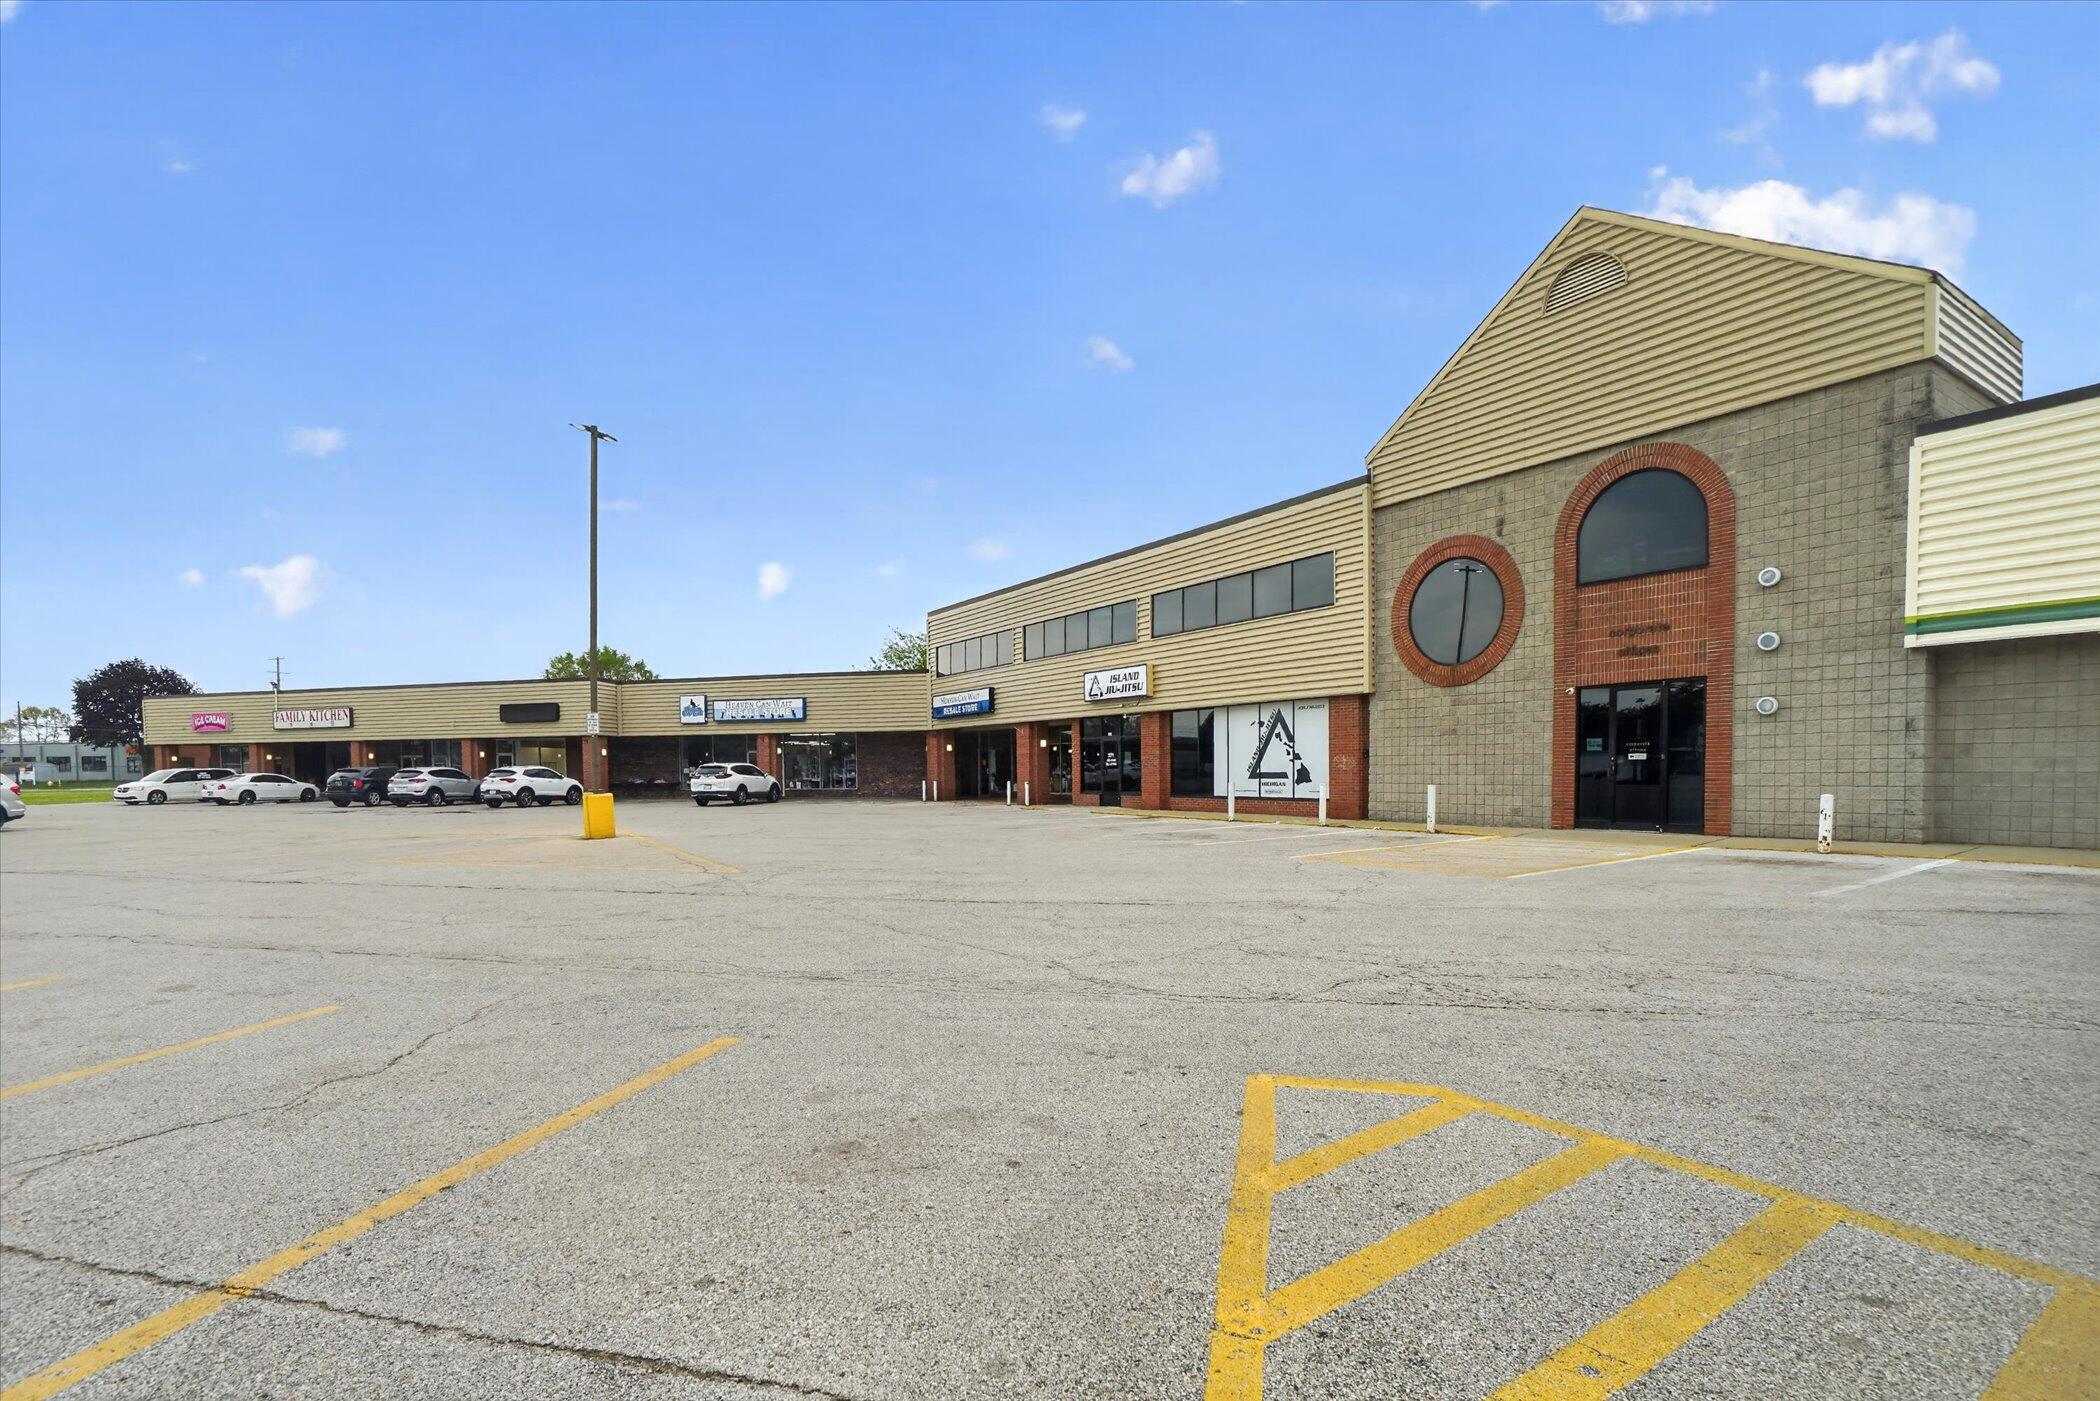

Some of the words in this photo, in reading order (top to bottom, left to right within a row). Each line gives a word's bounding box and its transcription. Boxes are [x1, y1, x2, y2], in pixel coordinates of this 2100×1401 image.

[1109, 671, 1140, 683] ISLAND
[1104, 682, 1144, 695] JIU-JITSU
[725, 700, 755, 709] HEAVEN
[755, 700, 771, 708] CAN
[772, 700, 793, 708] WAIT
[943, 705, 961, 715] RESALE
[961, 703, 978, 713] STORE
[275, 710, 306, 722] FAMILY
[308, 708, 349, 722] KITCHEN
[727, 708, 763, 716] RESALE
[763, 707, 791, 715] STORE
[194, 715, 204, 726] ICE
[204, 713, 227, 725] CREAM
